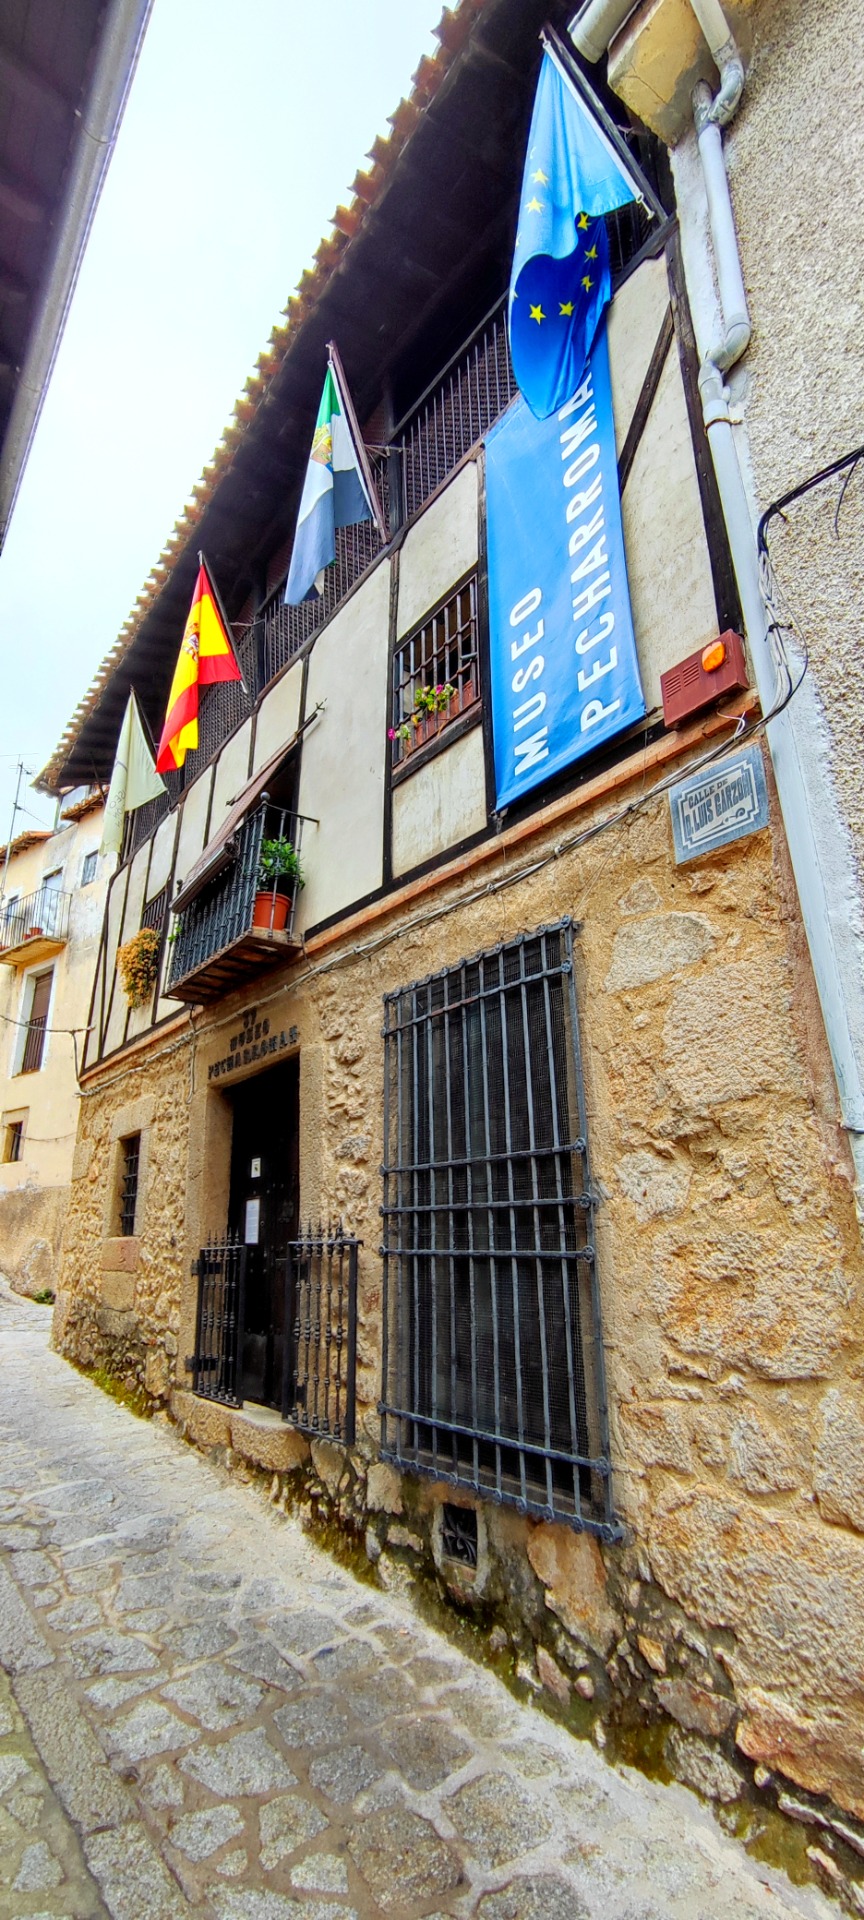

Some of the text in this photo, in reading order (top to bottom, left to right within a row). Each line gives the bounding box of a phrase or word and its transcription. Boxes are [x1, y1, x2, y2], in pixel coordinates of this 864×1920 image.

[558, 359, 621, 734] PECHARROMA
[510, 586, 550, 776] MUSEO
[688, 778, 728, 809] CALLE DE
[692, 800, 714, 832] LUIS
[230, 1018, 270, 1052] MUSEO
